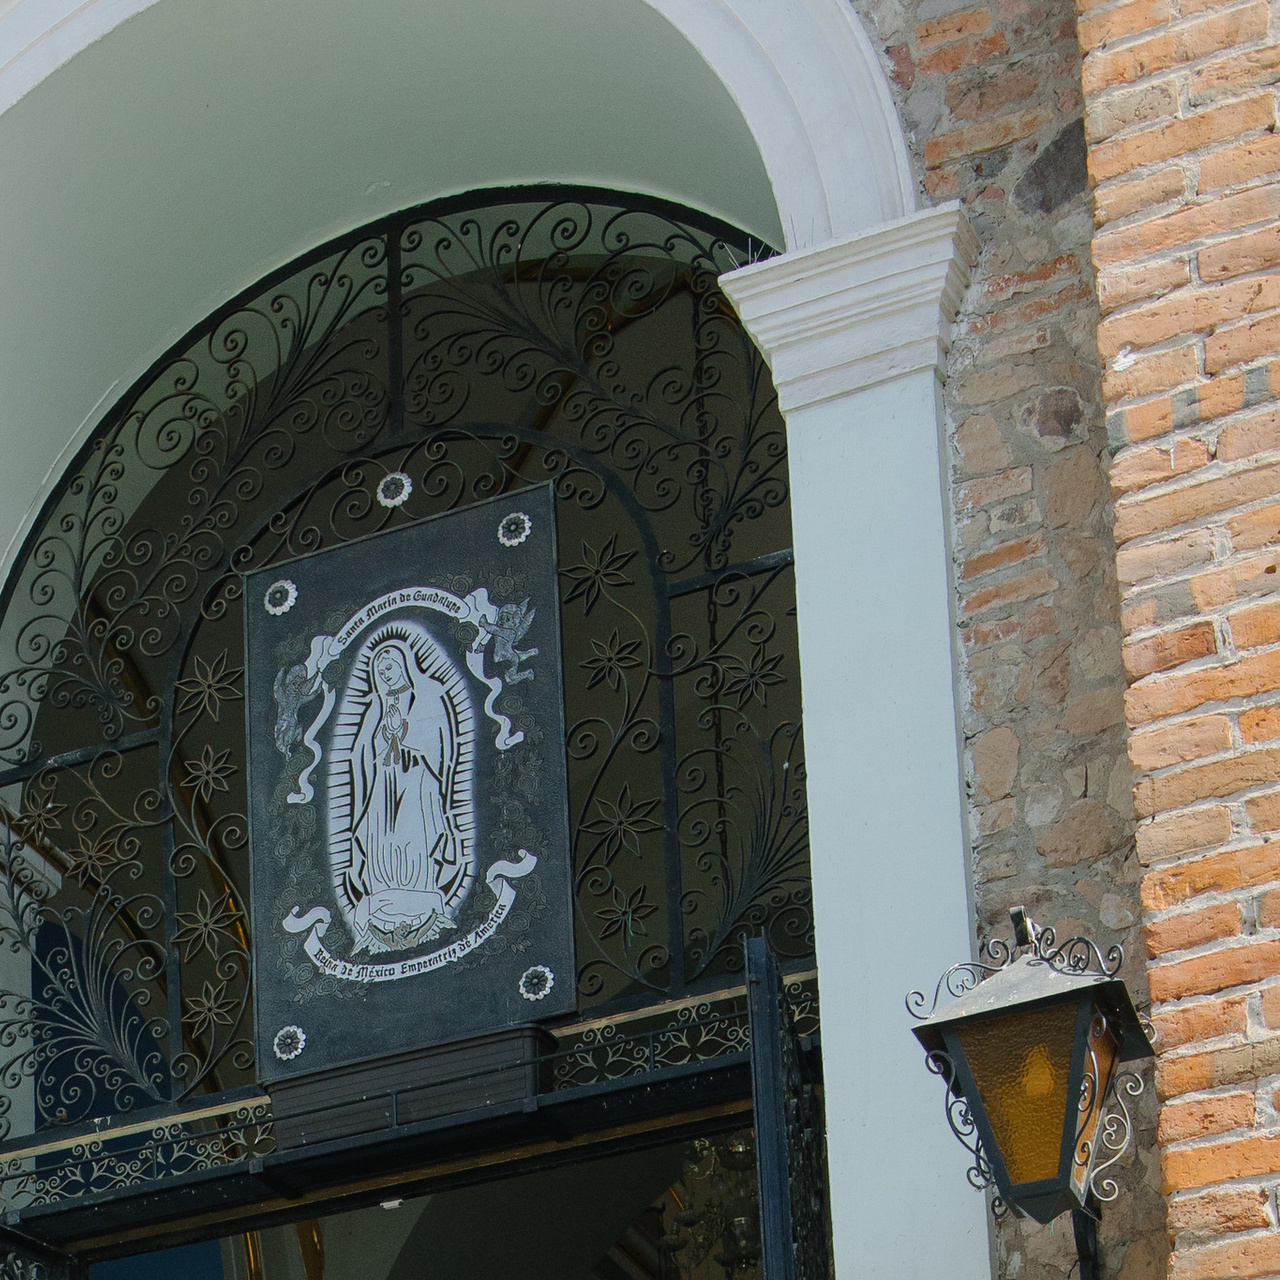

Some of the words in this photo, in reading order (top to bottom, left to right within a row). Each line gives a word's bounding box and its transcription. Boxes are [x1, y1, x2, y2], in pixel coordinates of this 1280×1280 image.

[338, 616, 365, 645] Santa
[366, 595, 397, 621] María
[399, 592, 411, 603] de
[413, 590, 461, 614] Guadalupe
[313, 948, 339, 972] Reina
[340, 965, 353, 976] de
[355, 965, 395, 978] México
[458, 941, 472, 952] de
